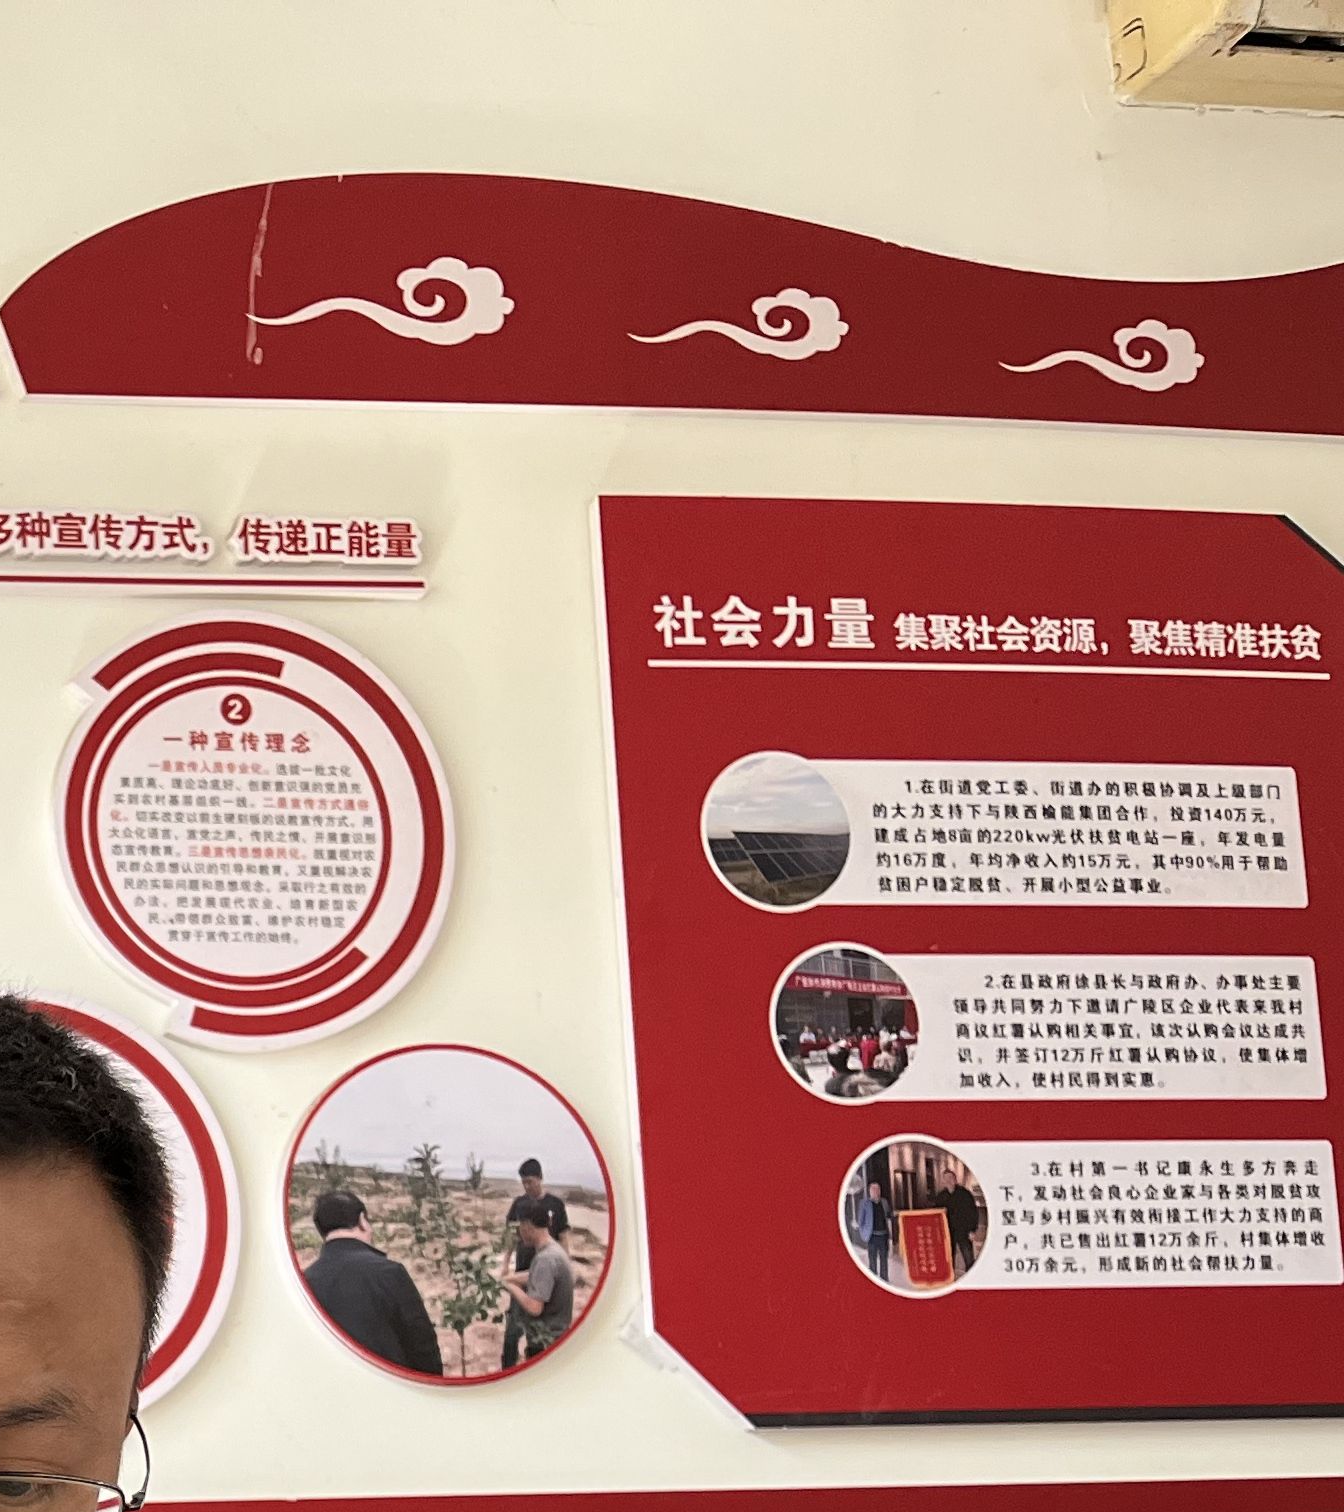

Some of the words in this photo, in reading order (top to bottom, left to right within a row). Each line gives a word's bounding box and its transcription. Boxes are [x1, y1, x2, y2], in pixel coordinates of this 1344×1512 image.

[653, 596, 876, 650] 社会力量
[894, 613, 1323, 661] 集聚社会资源，聚焦精准扶贫
[163, 730, 312, 753] 一种宣传理念
